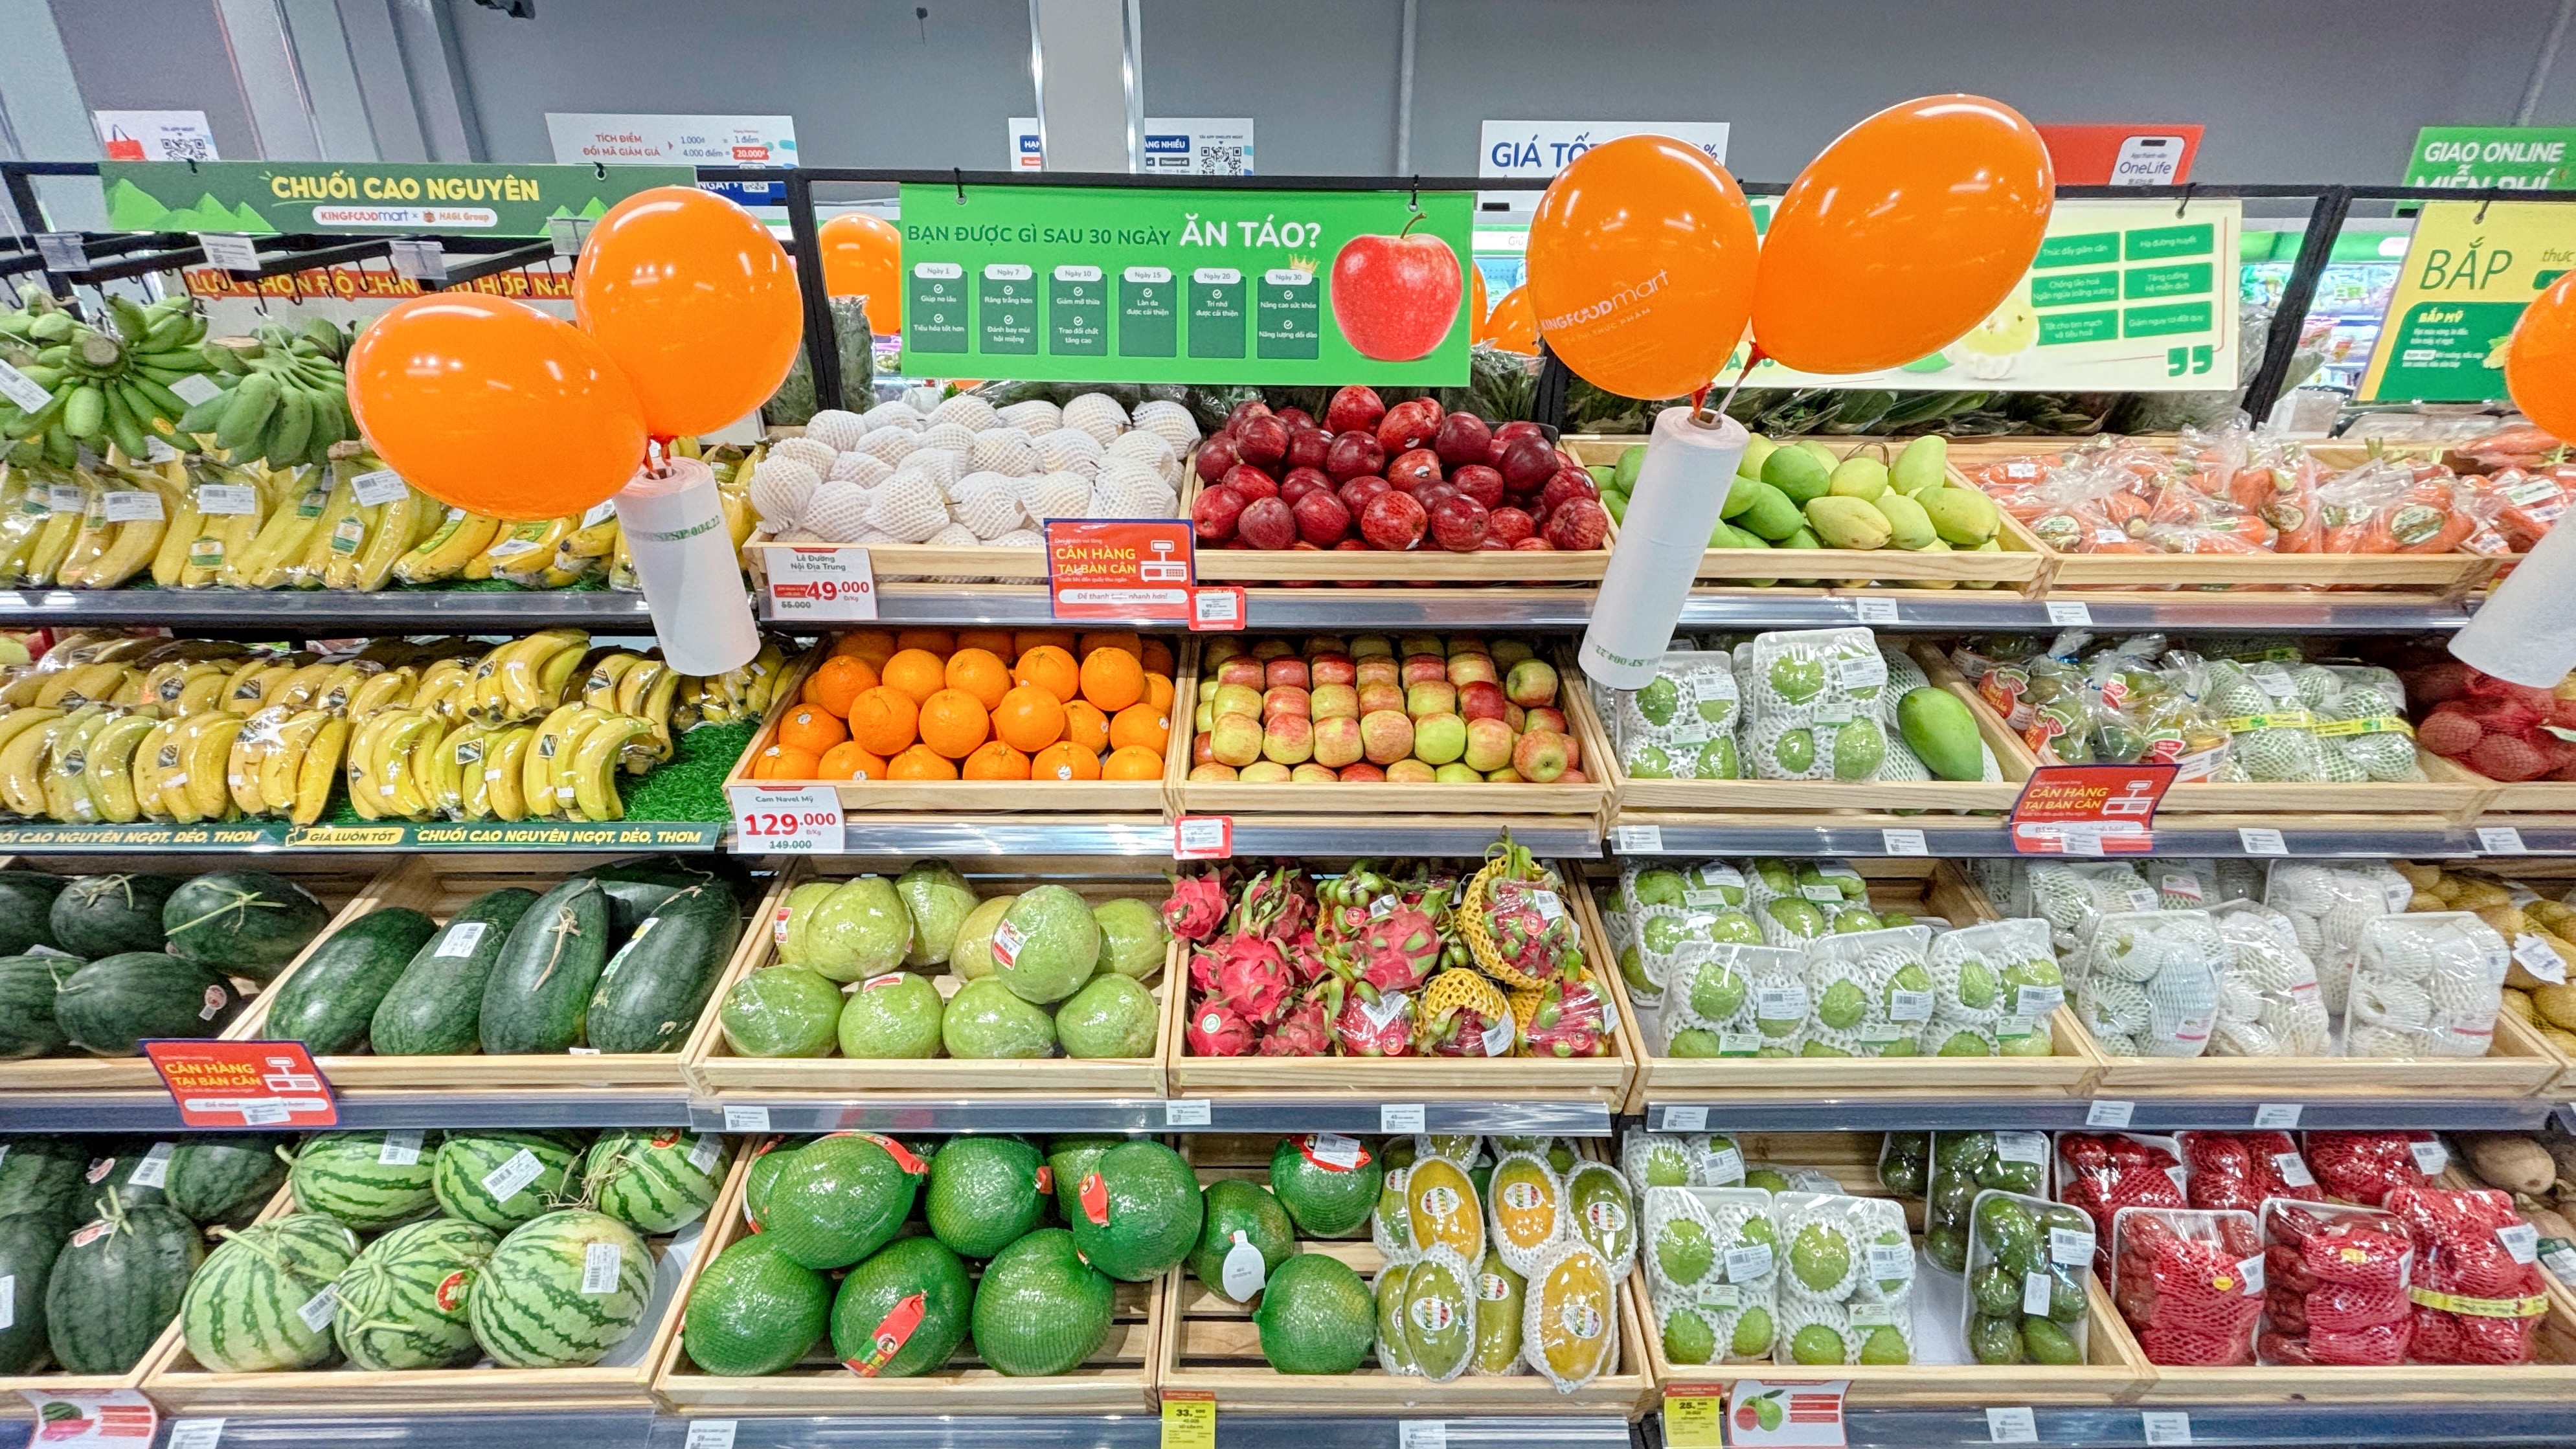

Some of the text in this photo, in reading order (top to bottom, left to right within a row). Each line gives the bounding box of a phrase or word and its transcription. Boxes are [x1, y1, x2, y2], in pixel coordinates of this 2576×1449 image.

[595, 132, 642, 143] TÍCH ĐIỂM
[1492, 132, 1599, 168] GIÁ TỐ
[2424, 142, 2566, 163] GIAO ONLINE
[2119, 161, 2172, 174] OneLife
[271, 170, 540, 201] CHUỐI CAO NGUYÊN
[439, 212, 462, 221] HAGL
[463, 212, 490, 223] Group
[908, 212, 1322, 249] BẠN ĐƯỢC GÌ SAU 30 NGÀY ĂN TÁO?
[2419, 236, 2513, 290] BẮP
[927, 267, 944, 276] Ngày
[1135, 271, 1151, 280] Ngày
[1204, 273, 1221, 281] Ngày
[2419, 307, 2443, 323] BẮP
[1056, 545, 1136, 560] CÂN HÀNG
[791, 563, 847, 572] Nội Địa Trung
[1081, 561, 1107, 574] BÀN
[1110, 561, 1137, 574] CÂN
[2029, 784, 2109, 798] CÂN HÀNG
[802, 795, 814, 803] Mỹ
[2025, 799, 2102, 811] TẠI BÀN CÂN
[744, 813, 837, 835] 129.000
[20, 832, 54, 843] CAO
[57, 829, 123, 844] NGUYÊN
[212, 830, 261, 842] THƠM
[335, 829, 369, 842] LUÔN
[371, 827, 396, 842] TỐT
[417, 827, 466, 842] CHUỐI
[469, 831, 501, 842] CAO
[504, 828, 568, 843] NGUYÊN
[571, 830, 616, 845] NGỌT,
[656, 830, 701, 844] THƠM
[164, 1061, 256, 1075] CÂN HÀNG
[198, 1075, 229, 1086] BÀN
[231, 1075, 263, 1086] CÂN
